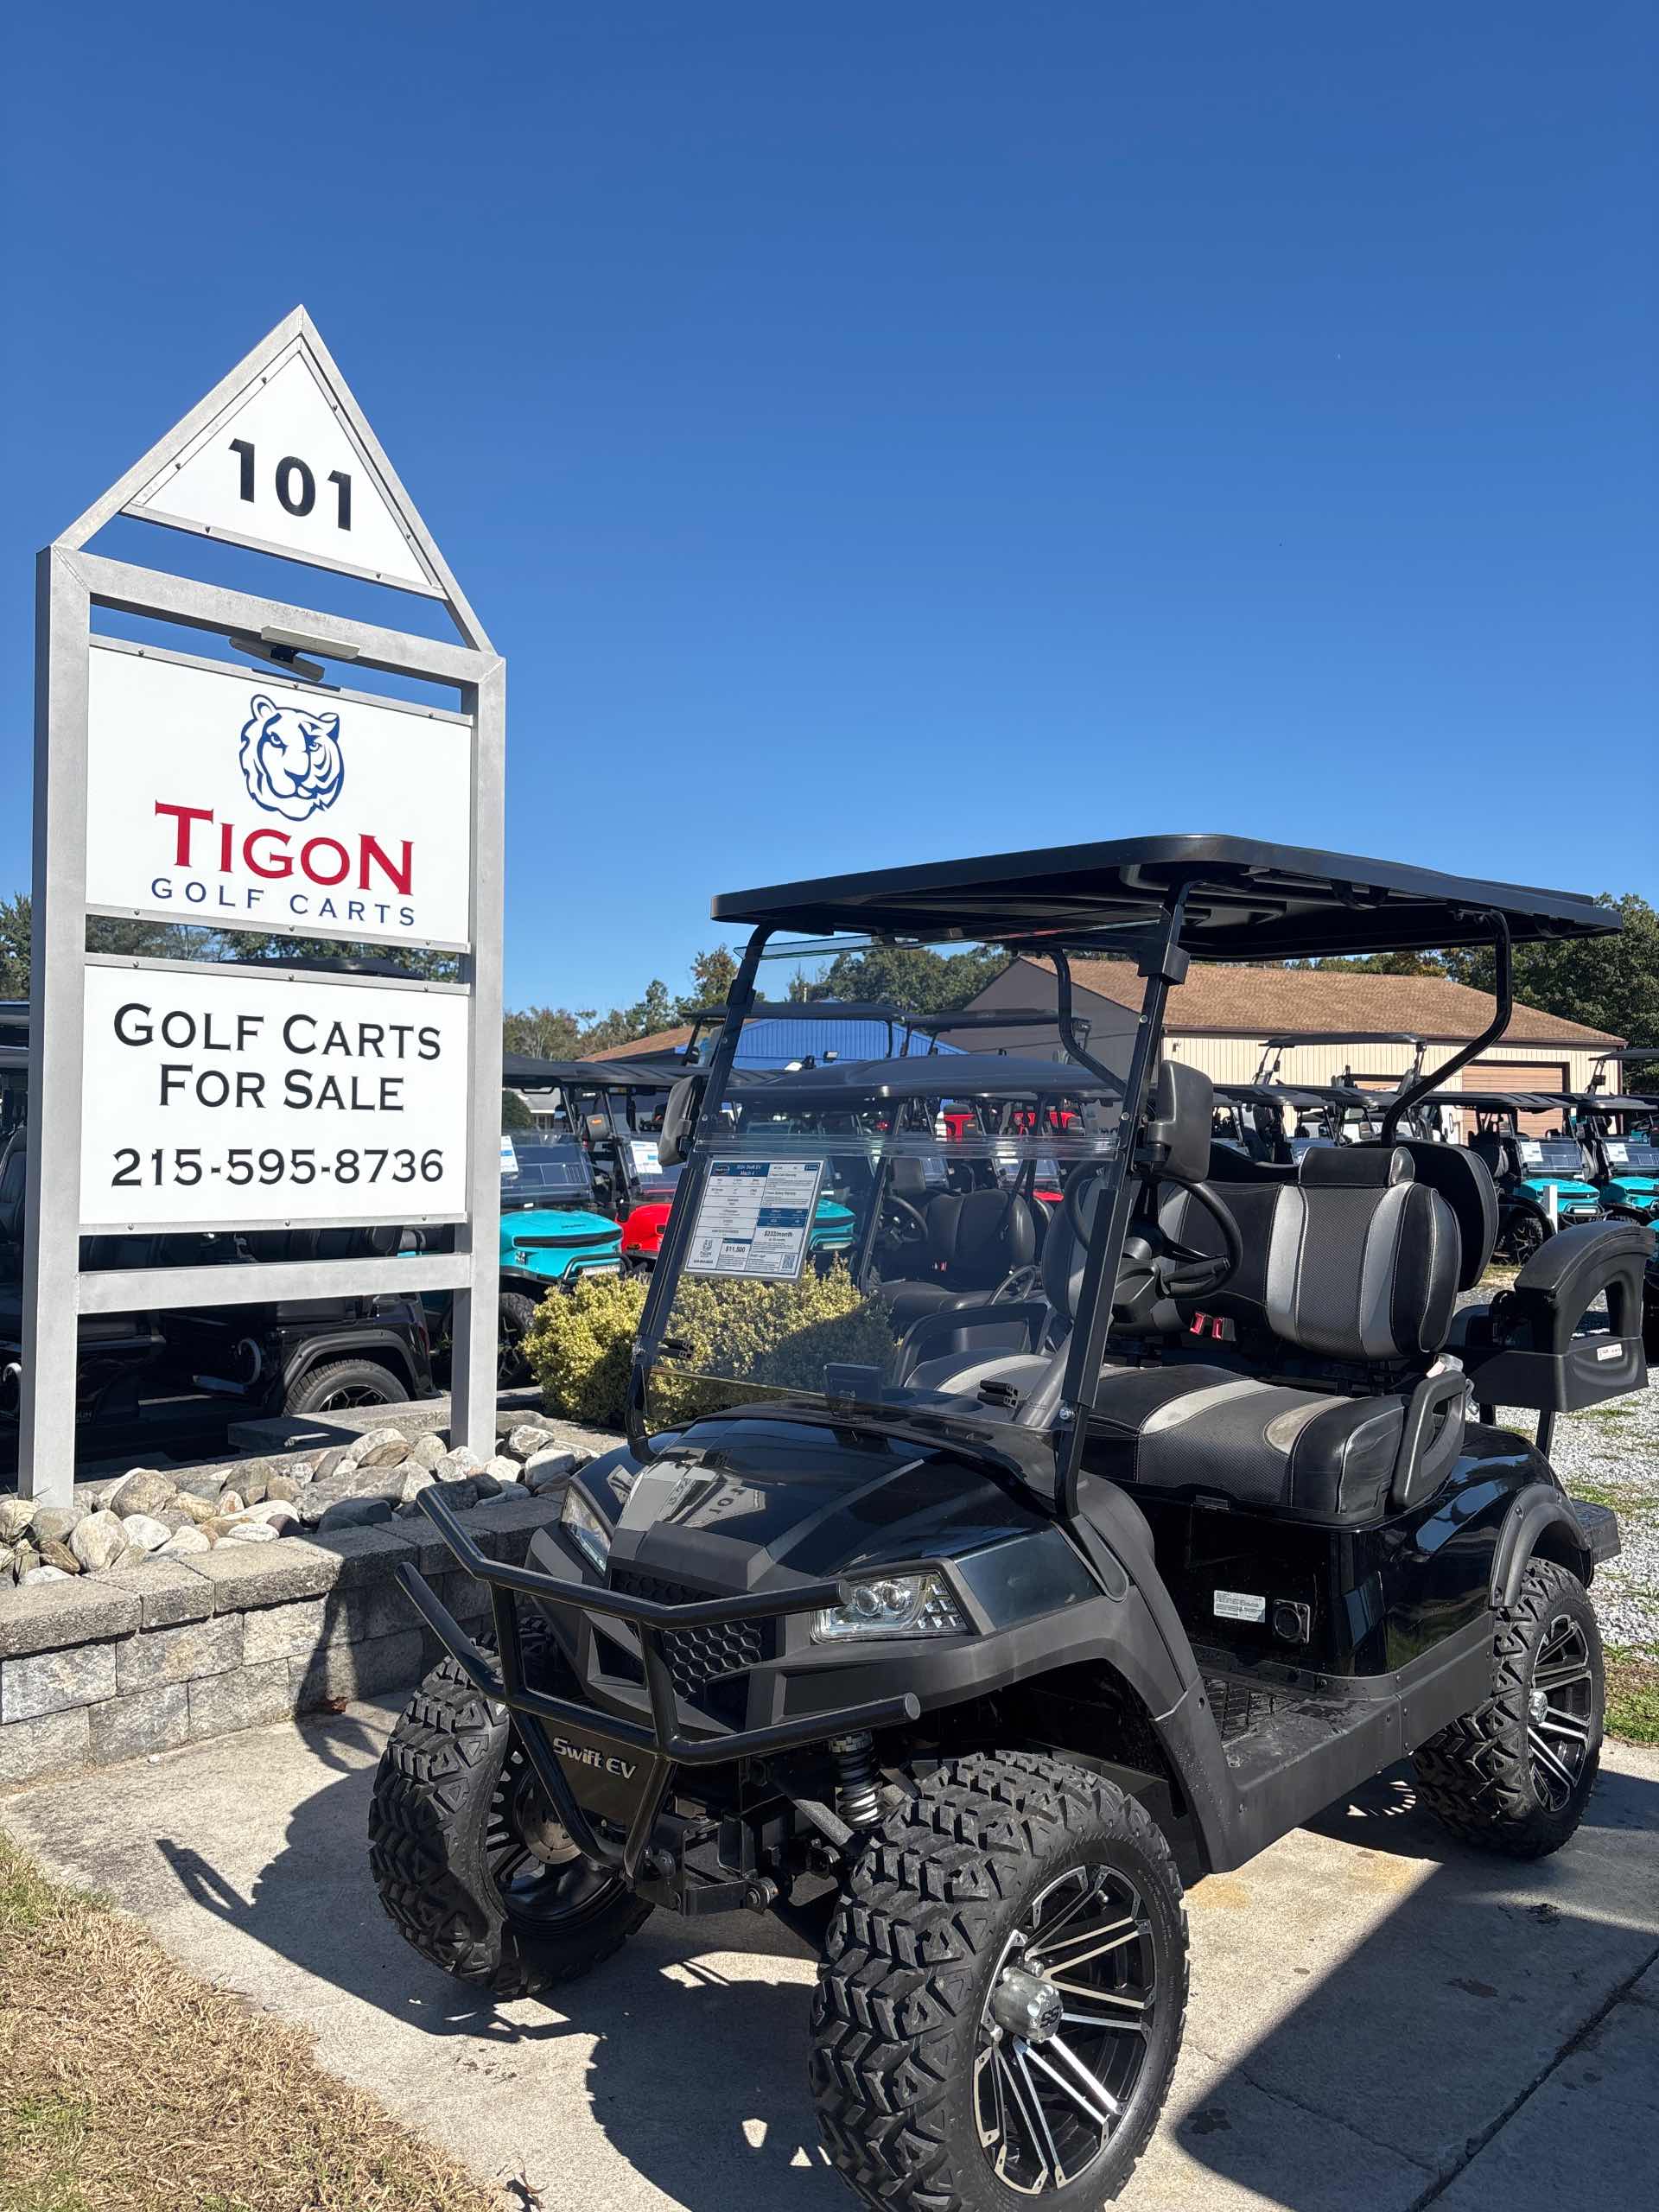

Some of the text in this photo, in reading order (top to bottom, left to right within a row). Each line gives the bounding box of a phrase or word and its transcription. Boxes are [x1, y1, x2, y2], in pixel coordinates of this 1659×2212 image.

[227, 438, 352, 531] 101
[155, 799, 414, 896] TIGON
[151, 877, 415, 926] GOLF CARTS
[113, 1002, 441, 1060] GOLF CARTS
[159, 1064, 404, 1111] FOR SALE
[111, 1147, 443, 1187] 215-595-8736
[552, 1736, 637, 1780] Swift EV
